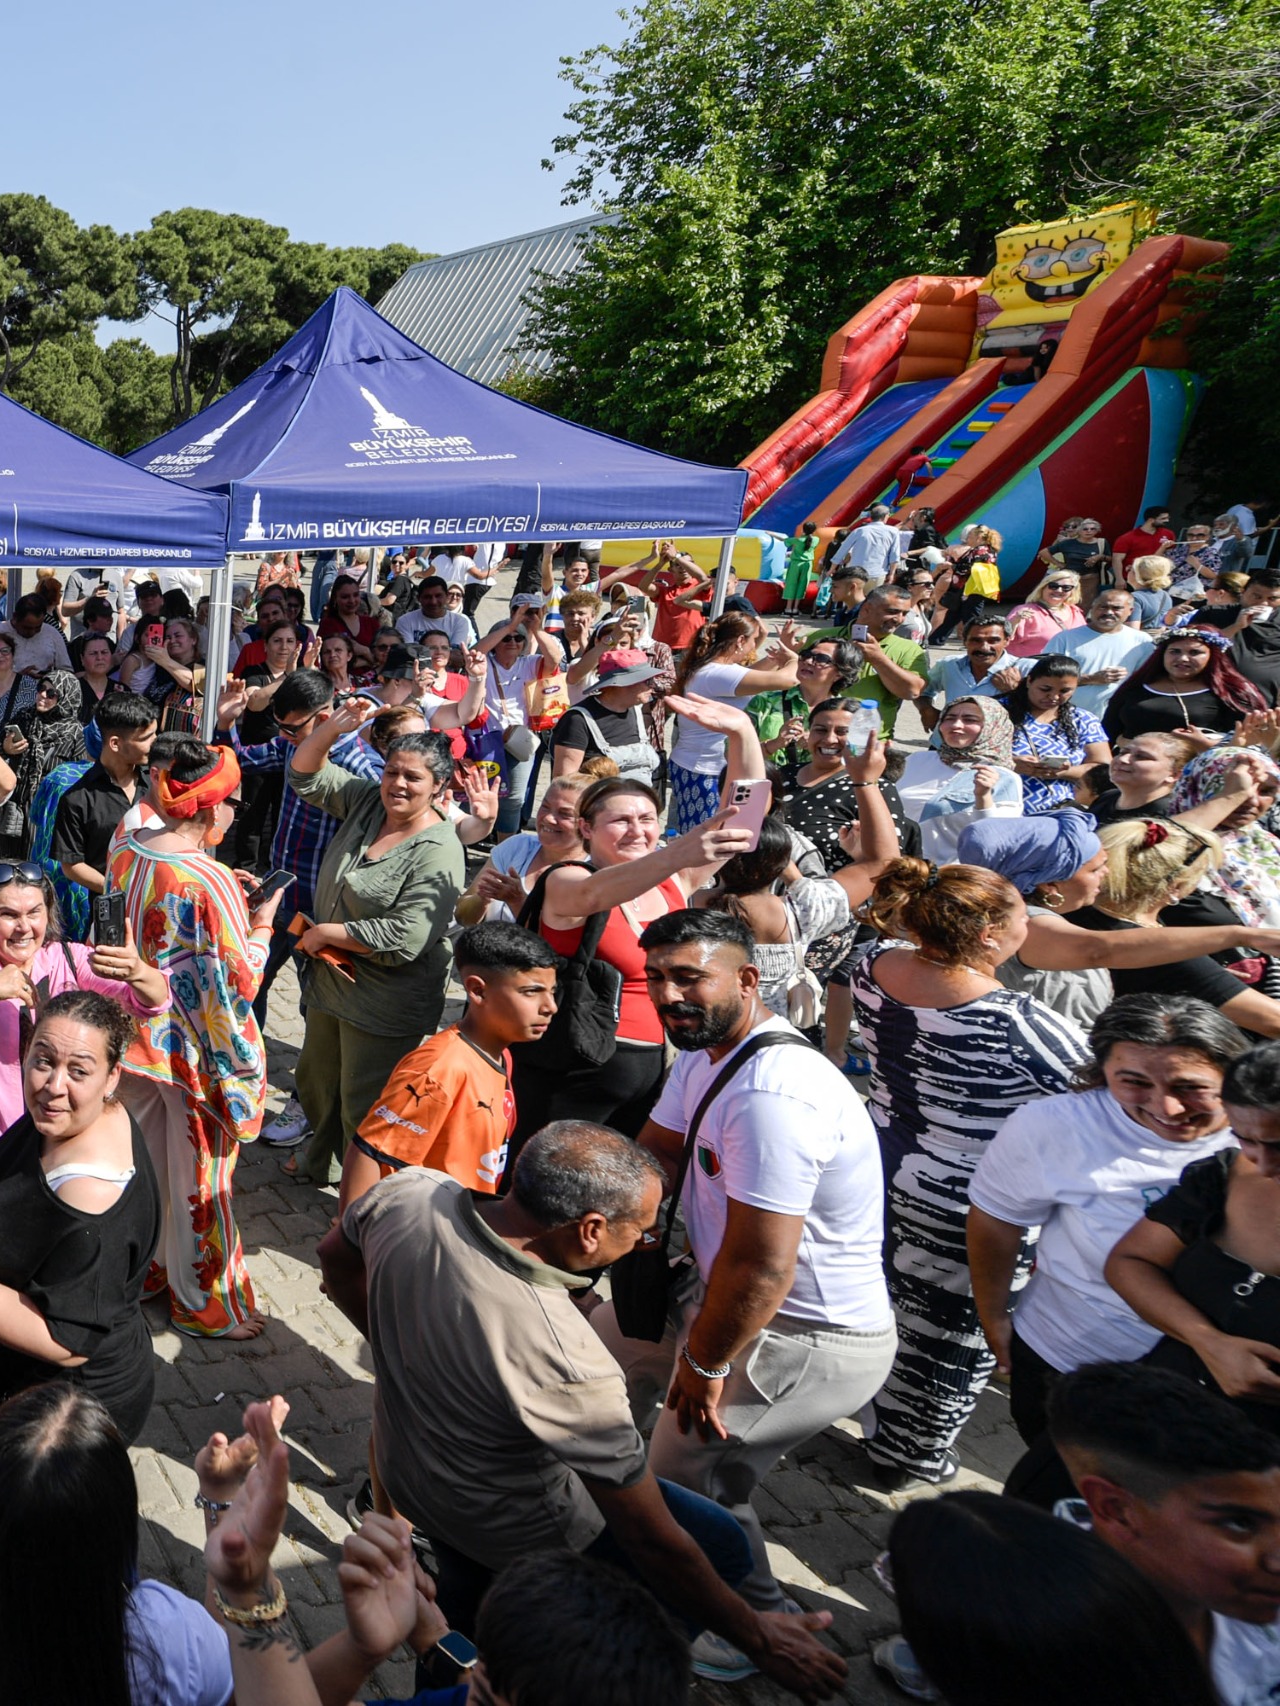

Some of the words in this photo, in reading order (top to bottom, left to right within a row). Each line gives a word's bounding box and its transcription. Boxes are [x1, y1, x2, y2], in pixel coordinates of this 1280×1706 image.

[371, 428, 430, 439] İZMİR
[349, 436, 472, 452] BÜYÜKŞEHİR
[364, 446, 477, 460] BELEDİYESİ
[270, 521, 319, 540] İZMİR
[323, 517, 430, 538] BÜYÜKŞEHİR
[434, 514, 530, 535] BELEDİYESİ
[539, 523, 569, 532] SOSYAL
[570, 521, 612, 531] HİZMETLER
[611, 520, 643, 530] DAİRESİ
[641, 519, 687, 530] BAŞKANLIĞI
[23, 547, 58, 557] SOSYAL
[59, 546, 107, 557] HİZMETLER
[109, 547, 141, 557] DAİRESİ
[142, 548, 192, 559] BAŞKANLIĞI
